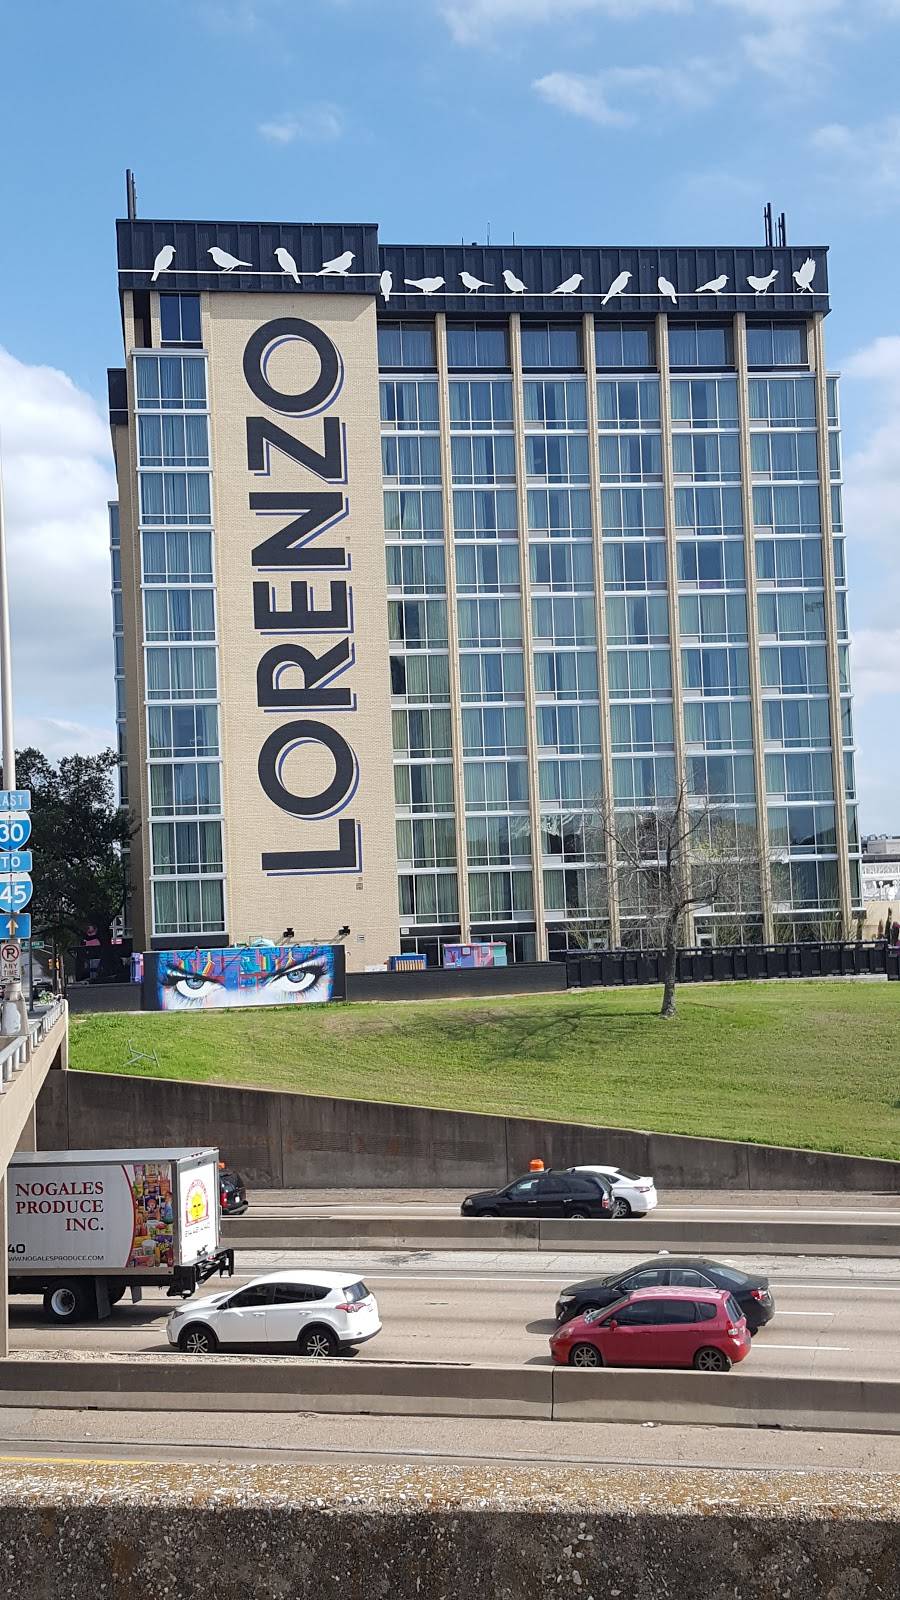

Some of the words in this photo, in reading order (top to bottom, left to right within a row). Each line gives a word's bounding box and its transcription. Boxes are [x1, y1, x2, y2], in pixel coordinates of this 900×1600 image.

[243, 317, 362, 876] LORENZO
[0, 794, 24, 807] AST
[0, 823, 24, 843] 30
[1, 856, 21, 868] TO
[0, 884, 27, 904] 45
[15, 1181, 104, 1197] NOGALES
[15, 1199, 104, 1215] PRODUCE
[65, 1217, 104, 1232] INC.
